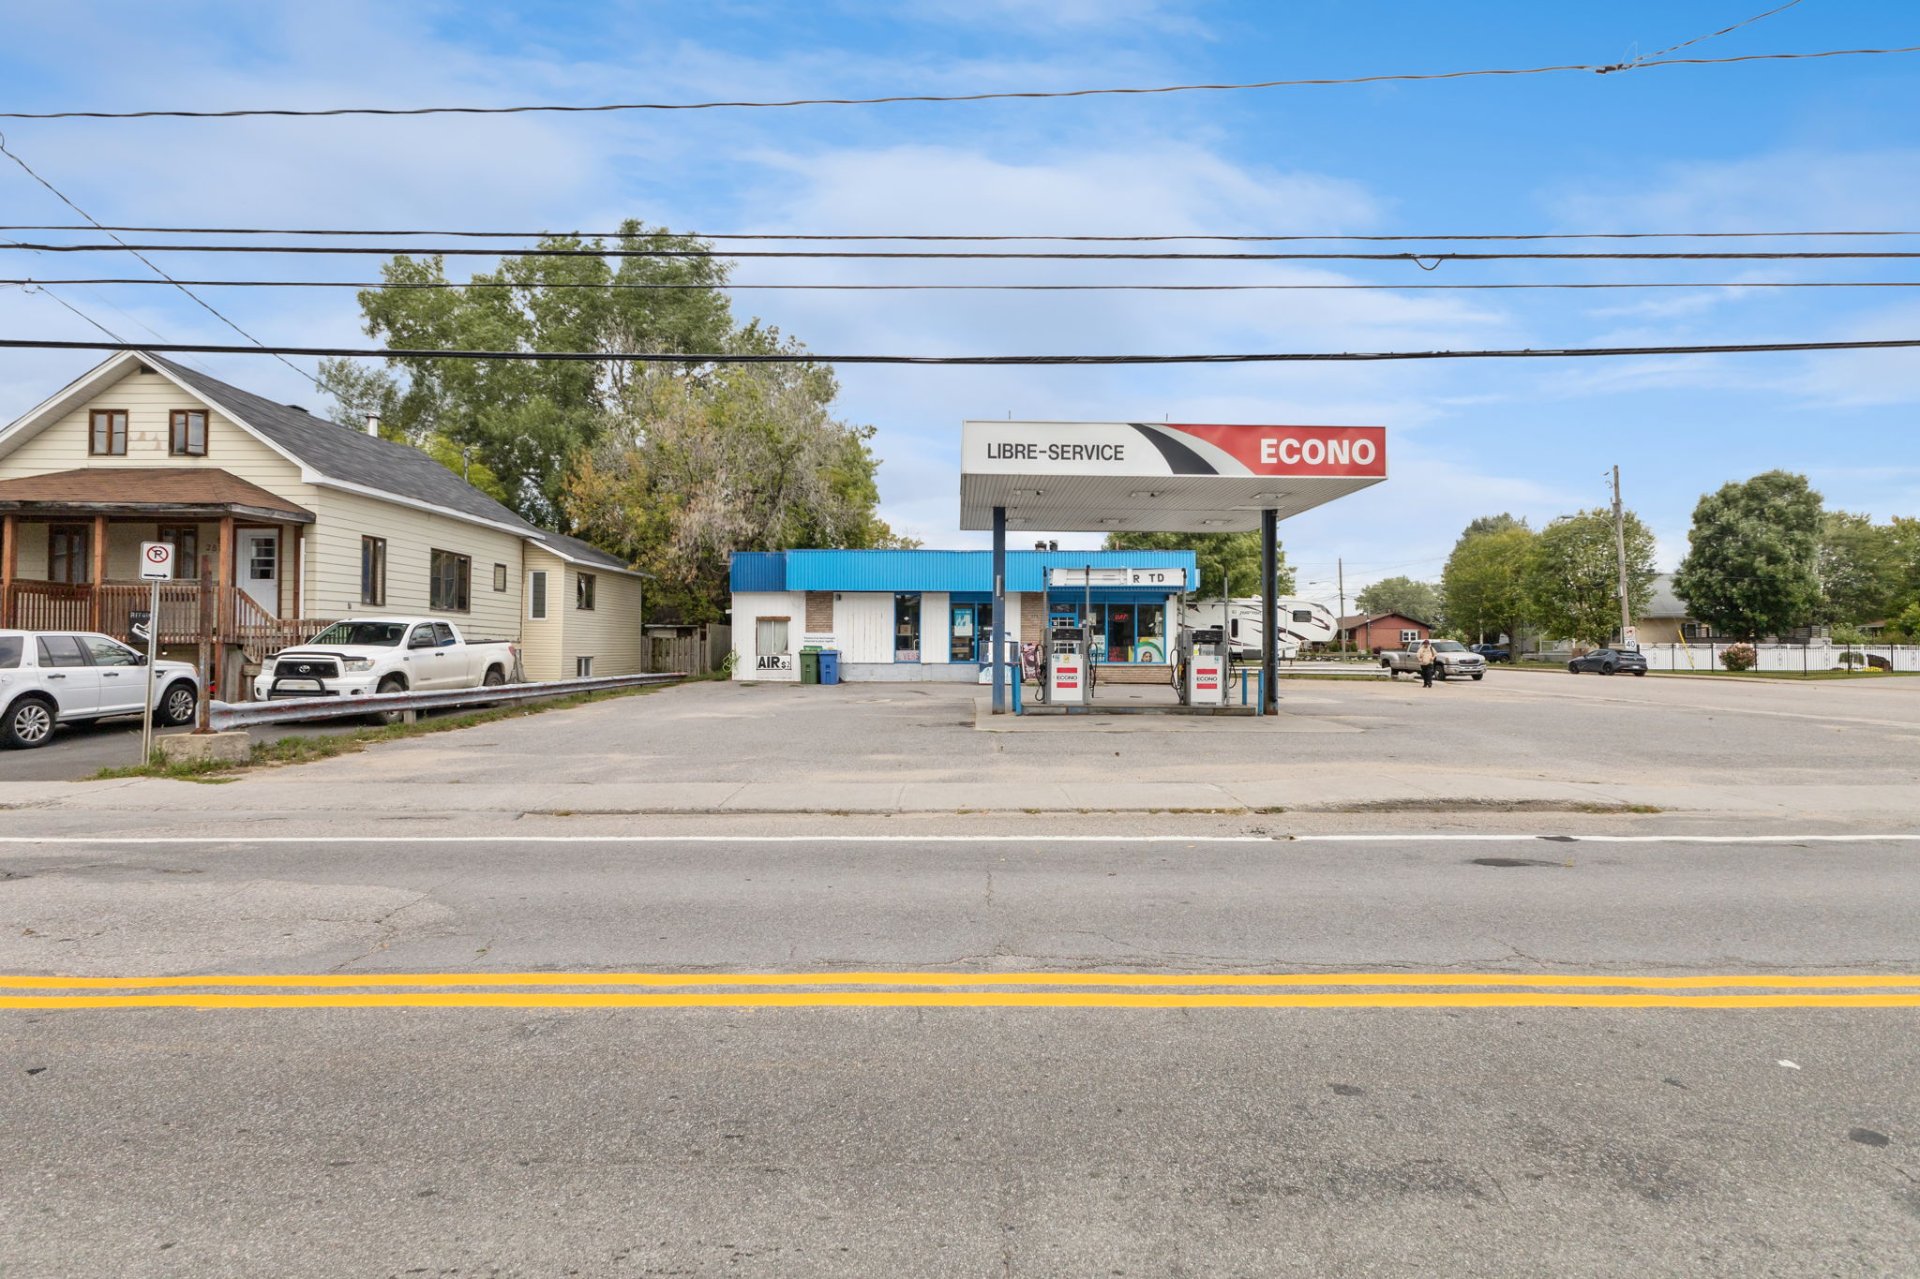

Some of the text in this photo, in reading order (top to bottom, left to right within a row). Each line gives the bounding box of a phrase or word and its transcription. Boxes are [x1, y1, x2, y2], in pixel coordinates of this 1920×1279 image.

[987, 443, 1124, 461] LIBRE-SERVICE
[1260, 438, 1376, 465] ECONO
[758, 656, 781, 669] AIR
